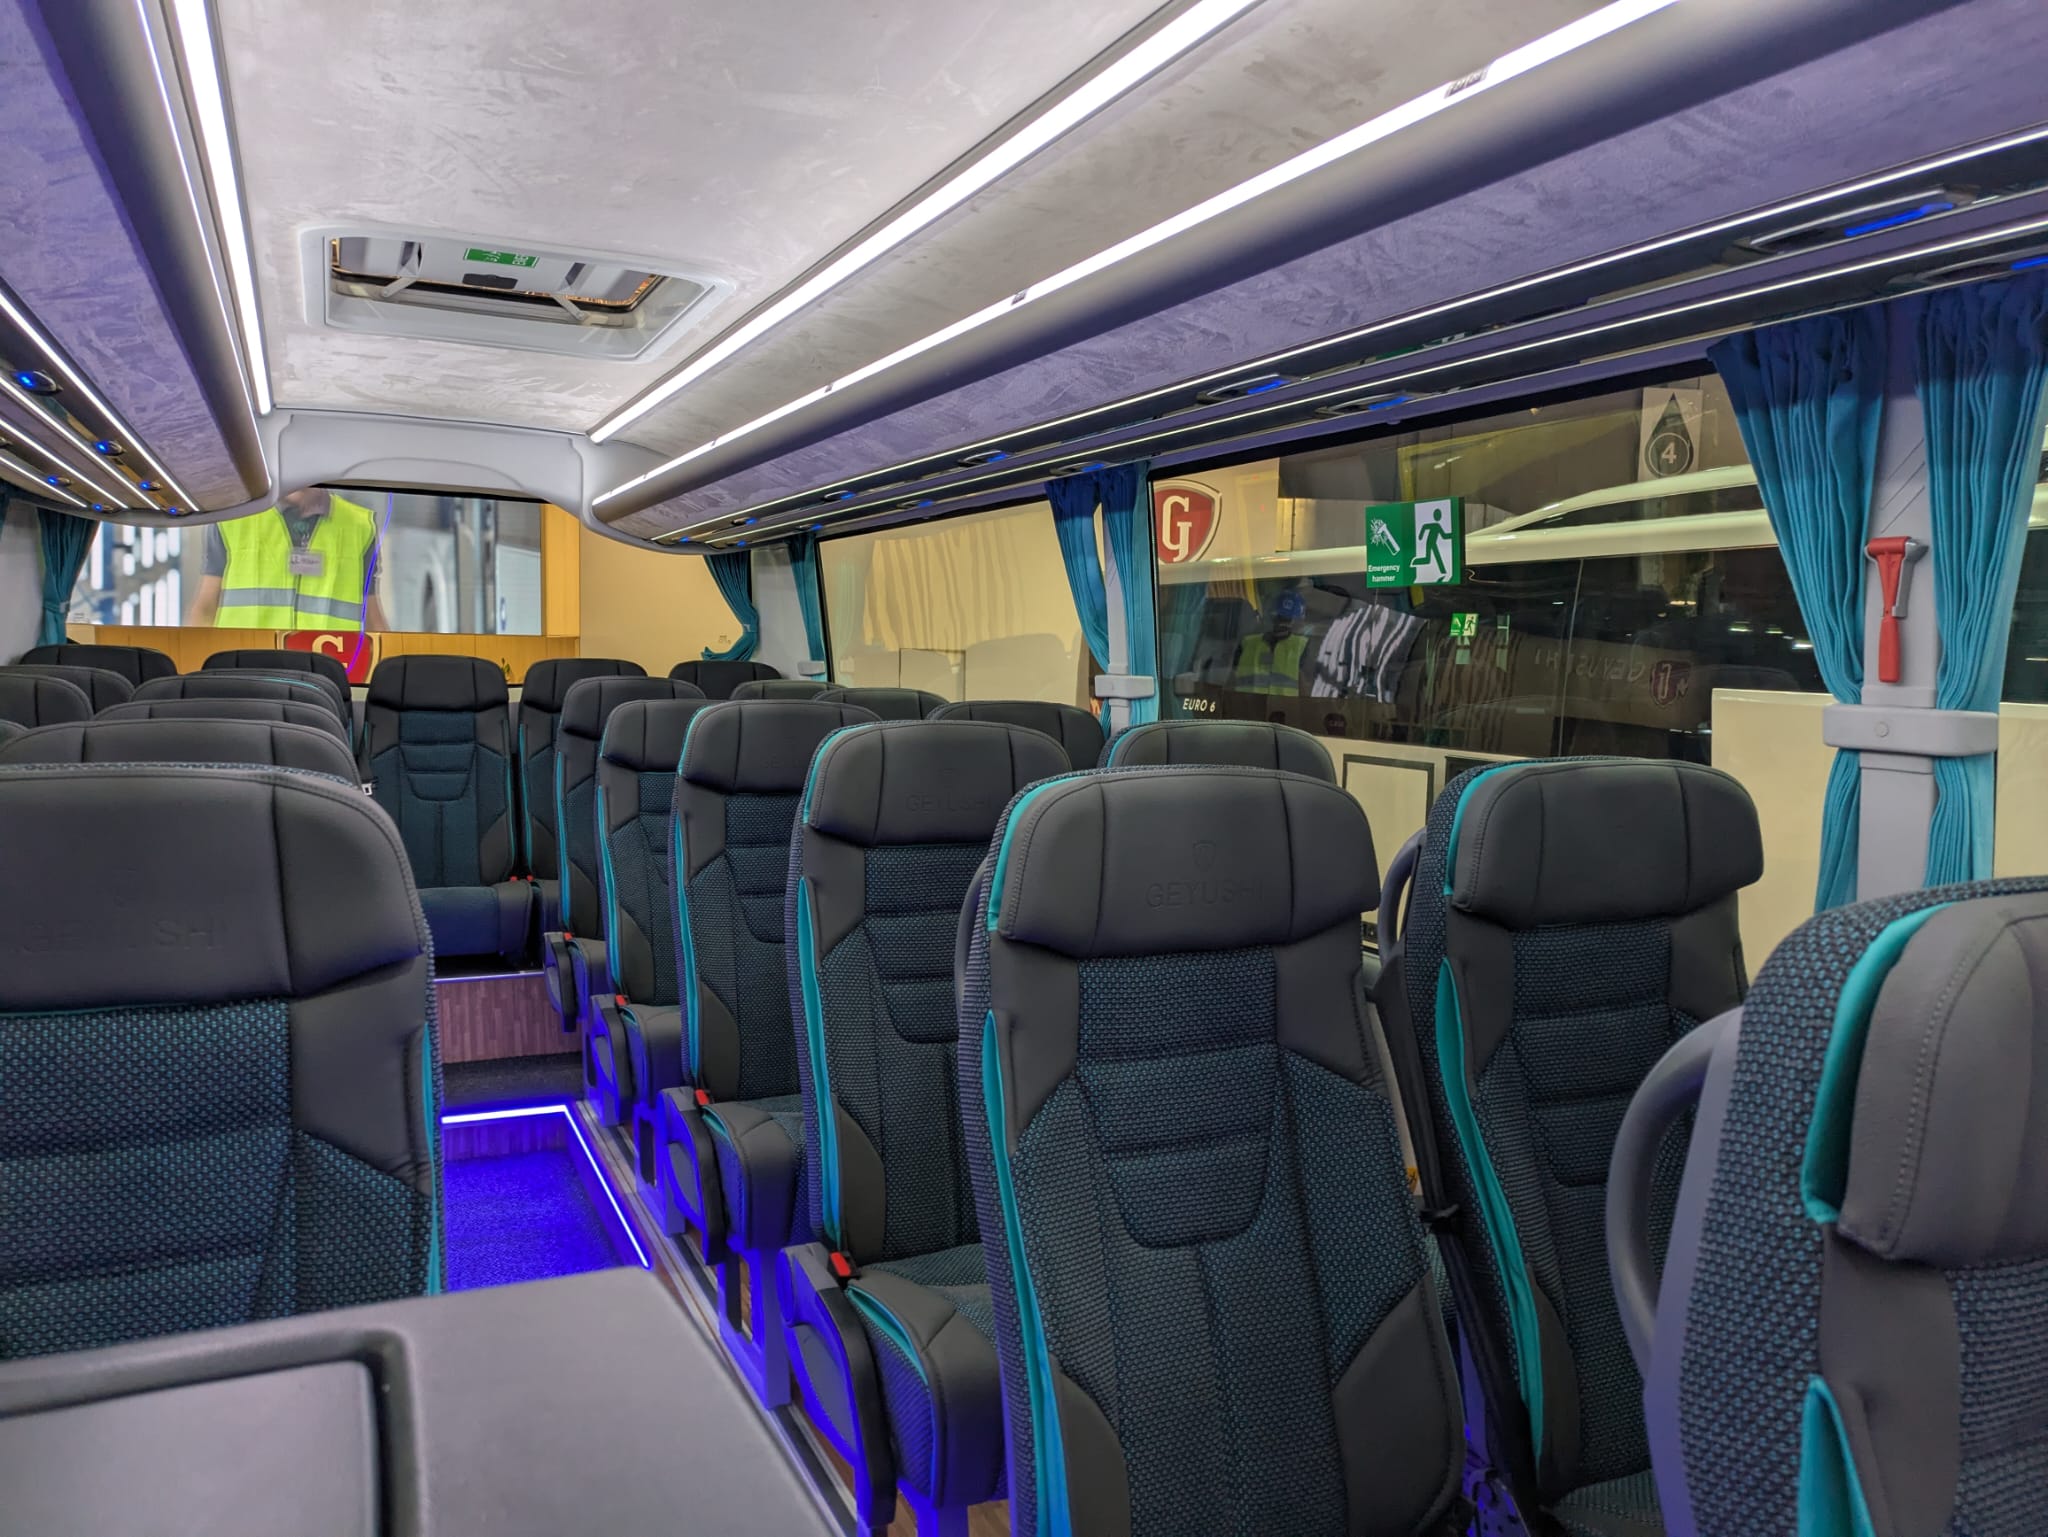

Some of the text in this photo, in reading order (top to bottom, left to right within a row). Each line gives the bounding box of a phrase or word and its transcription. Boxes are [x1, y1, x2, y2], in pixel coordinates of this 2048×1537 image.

[1661, 441, 1677, 464] 4
[1162, 495, 1192, 562] G
[1367, 564, 1400, 573] Emergency
[1182, 697, 1216, 712] EURO 6
[1145, 879, 1264, 909] GEYUSHI
